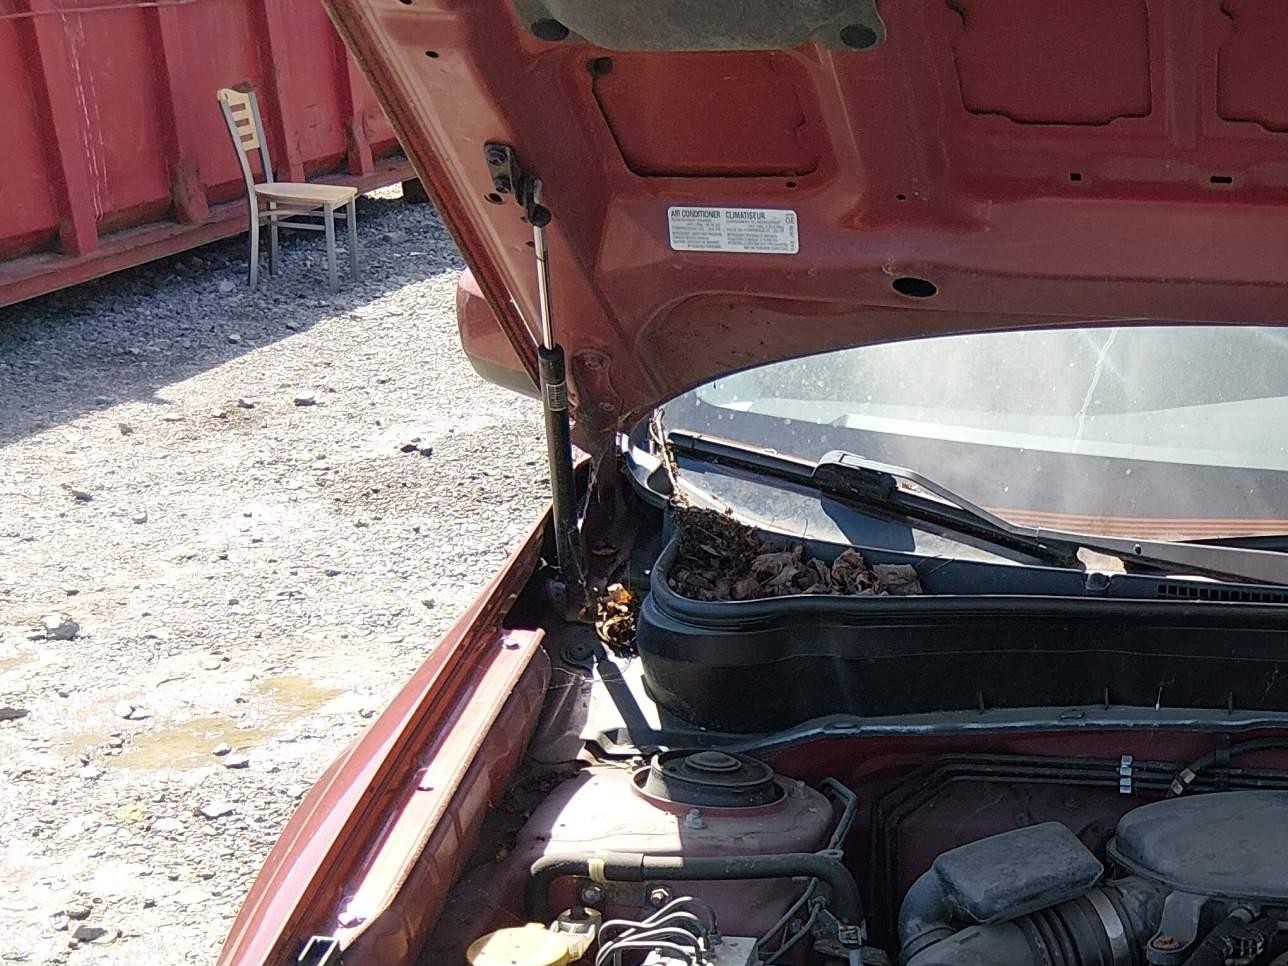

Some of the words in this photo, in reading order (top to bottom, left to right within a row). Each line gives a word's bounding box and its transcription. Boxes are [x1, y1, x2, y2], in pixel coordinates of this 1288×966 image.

[671, 209, 681, 218] AIR
[682, 209, 721, 219] CONDITIONER
[725, 210, 766, 220] CLIMATISEUR
